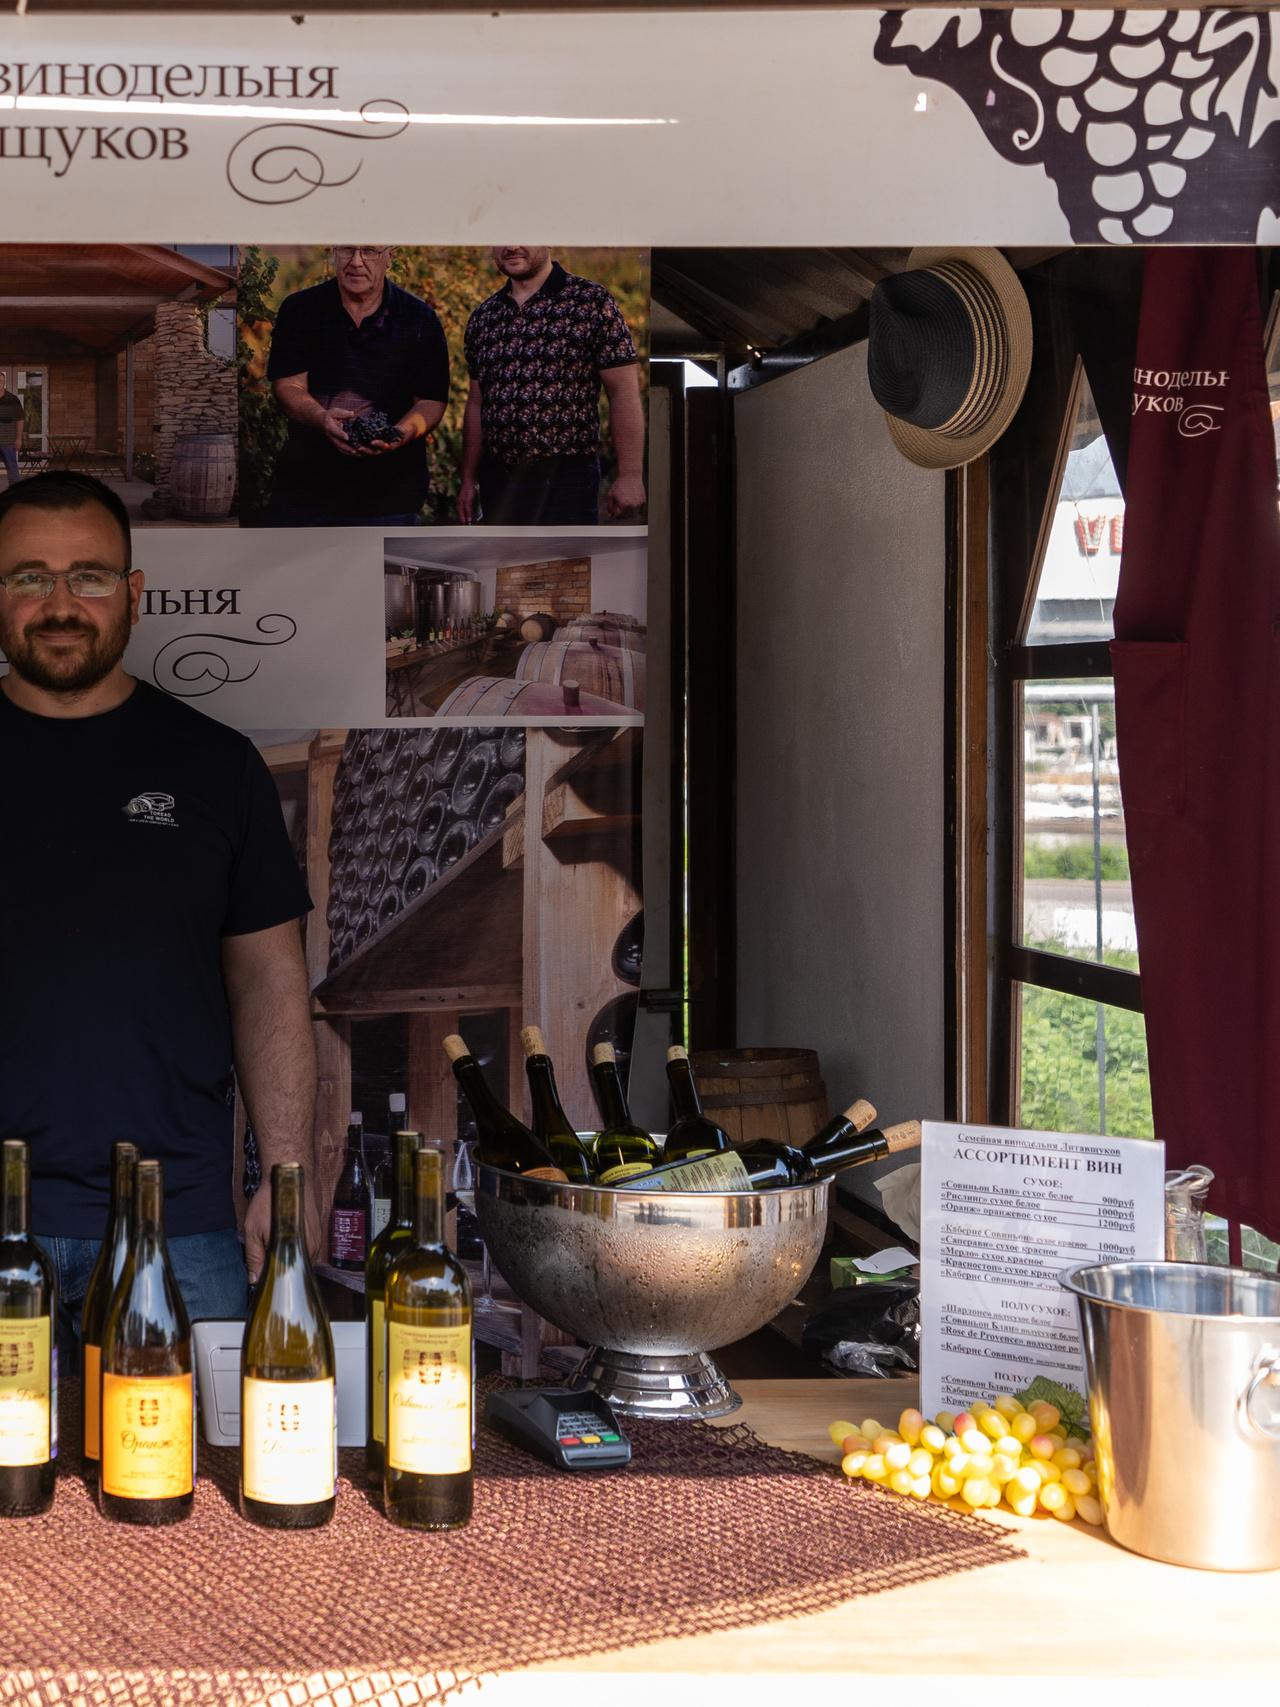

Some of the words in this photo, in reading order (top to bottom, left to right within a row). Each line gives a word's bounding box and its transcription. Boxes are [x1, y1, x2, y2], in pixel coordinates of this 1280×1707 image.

[1132, 393, 1184, 416] уков
[957, 1133, 1002, 1144] Семейная
[1004, 1139, 1058, 1151] винодельня
[1060, 1142, 1121, 1156] Литавщуков
[953, 1147, 1081, 1171] АССОРТИМЕНТ
[1086, 1159, 1123, 1175] ВИН
[1023, 1176, 1063, 1189] СУХОЕ:
[990, 1197, 1013, 1207] сухое
[1015, 1198, 1040, 1210] белое
[1098, 1207, 1135, 1220] 1000руб
[1022, 1190, 1047, 1199] сухое
[1048, 1190, 1074, 1201] белое
[1102, 1196, 1135, 1209] 900руб
[1033, 1213, 1058, 1223] сухое
[1098, 1219, 1136, 1232] 1200руб
[996, 1243, 1019, 1253] сухое
[1098, 1242, 1136, 1255] 1000руб
[981, 1253, 1005, 1264] сухое
[1007, 1256, 1044, 1267] красное
[1004, 1265, 1029, 1276] сухое
[1031, 1269, 1058, 1280] красн
[1000, 1300, 1071, 1317] ПОЛУСУХОЕ:
[940, 1326, 966, 1338] «Rose
[967, 1328, 978, 1338] de
[121, 1430, 173, 1454] Оранж
